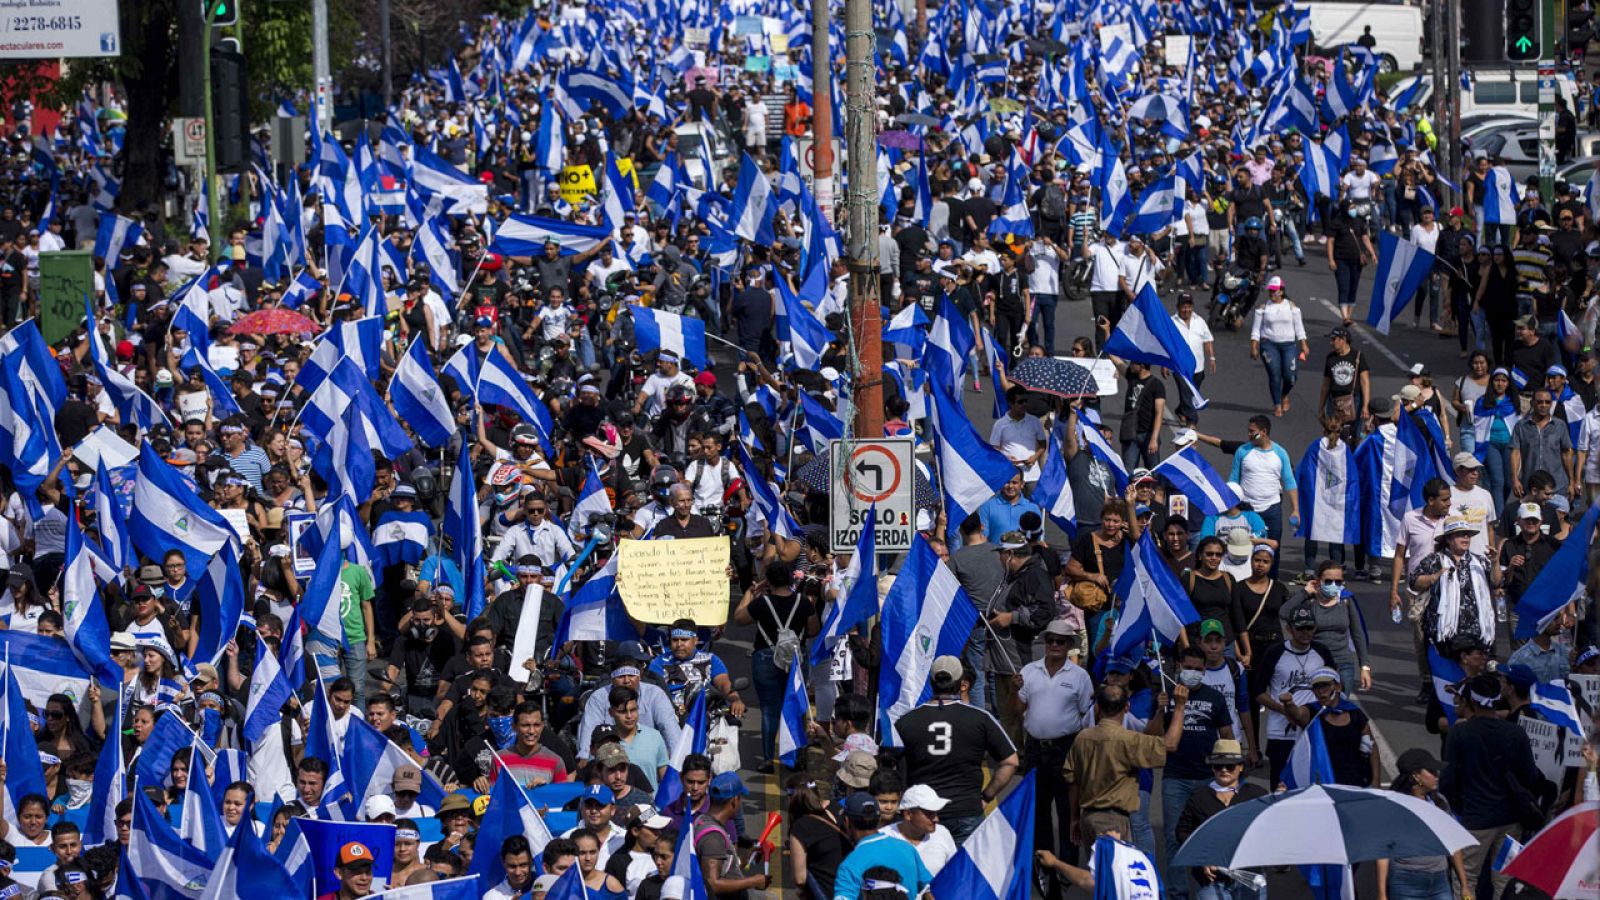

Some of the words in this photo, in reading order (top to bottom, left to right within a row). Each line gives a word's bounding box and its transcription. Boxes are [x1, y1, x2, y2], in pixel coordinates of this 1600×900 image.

[13, 15, 82, 31] 2278-6845
[849, 508, 895, 525] SOLO
[835, 529, 910, 546] IZQERDA
[927, 721, 953, 756] 3
